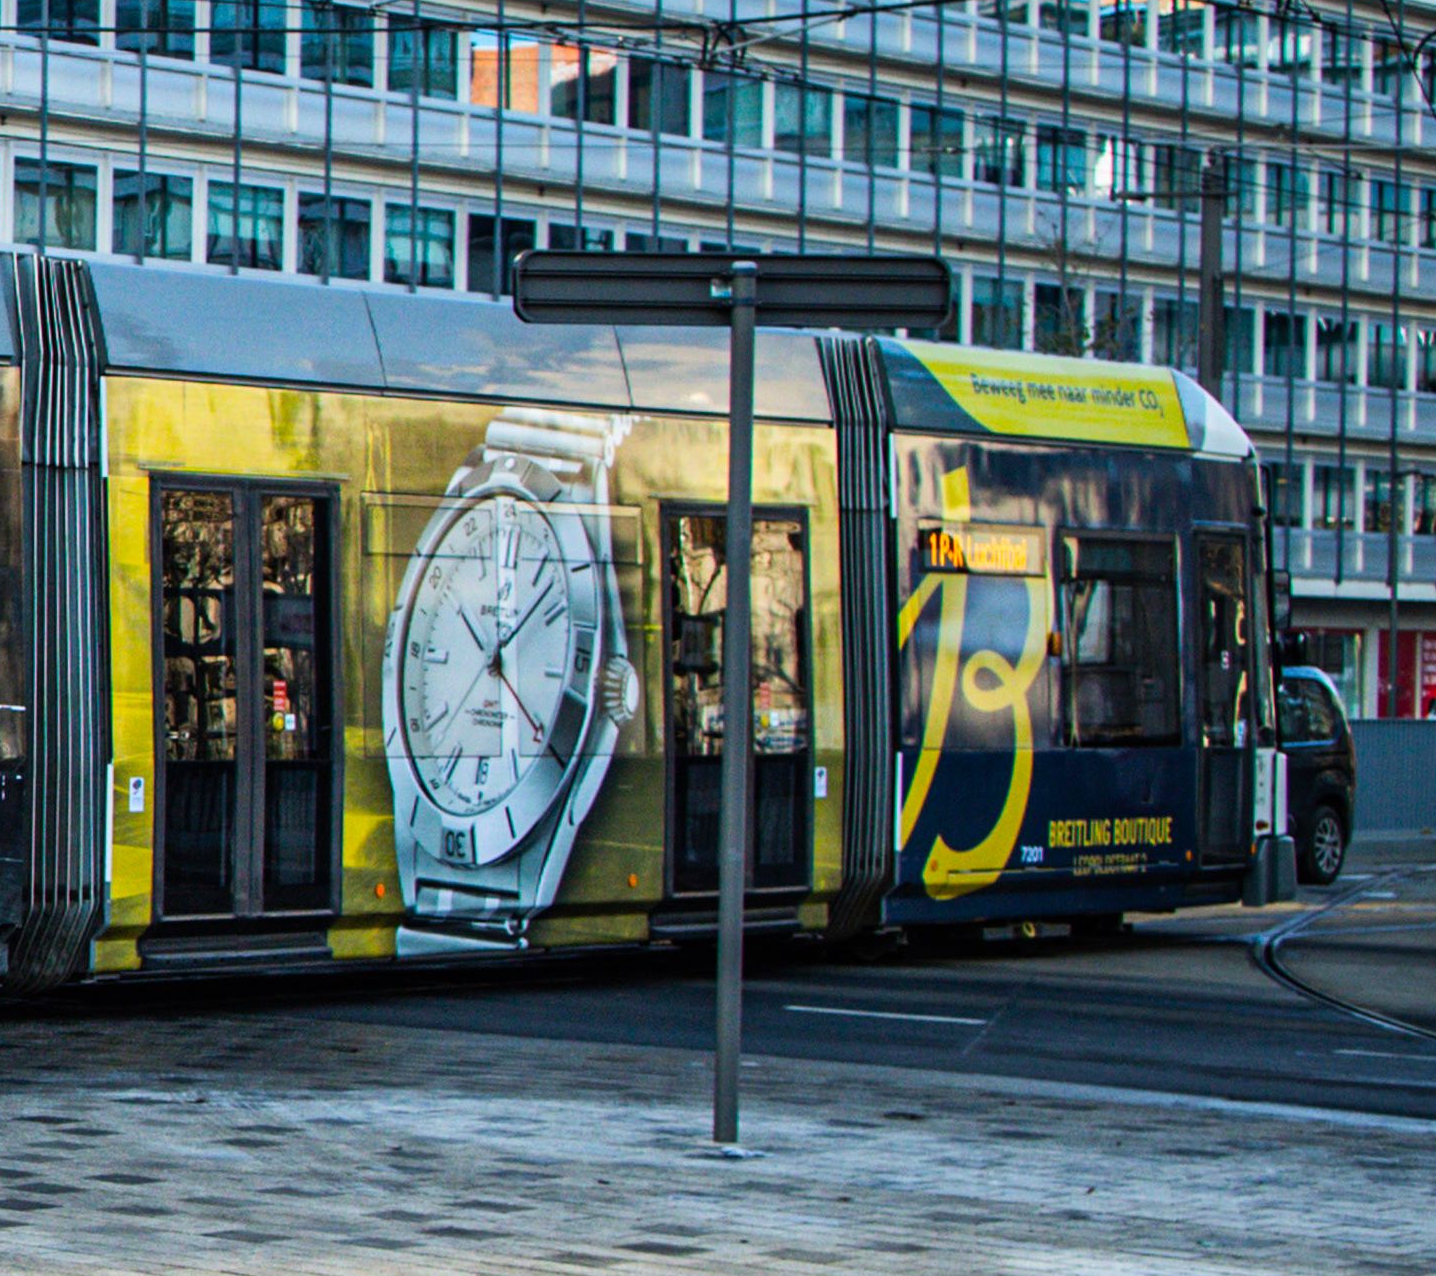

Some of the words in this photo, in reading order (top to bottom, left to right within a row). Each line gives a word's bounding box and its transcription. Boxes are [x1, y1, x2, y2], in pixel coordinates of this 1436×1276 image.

[970, 372, 1027, 405] Beweeg
[1027, 383, 1056, 401] mee
[1057, 385, 1087, 403] naar
[1092, 384, 1135, 407] minder
[464, 517, 478, 536] 22
[929, 533, 937, 566] 1
[444, 829, 466, 858] 30
[1049, 819, 1111, 848] BREITLING
[1114, 817, 1173, 846] BOUTIQUE
[1020, 845, 1043, 862] 7201
